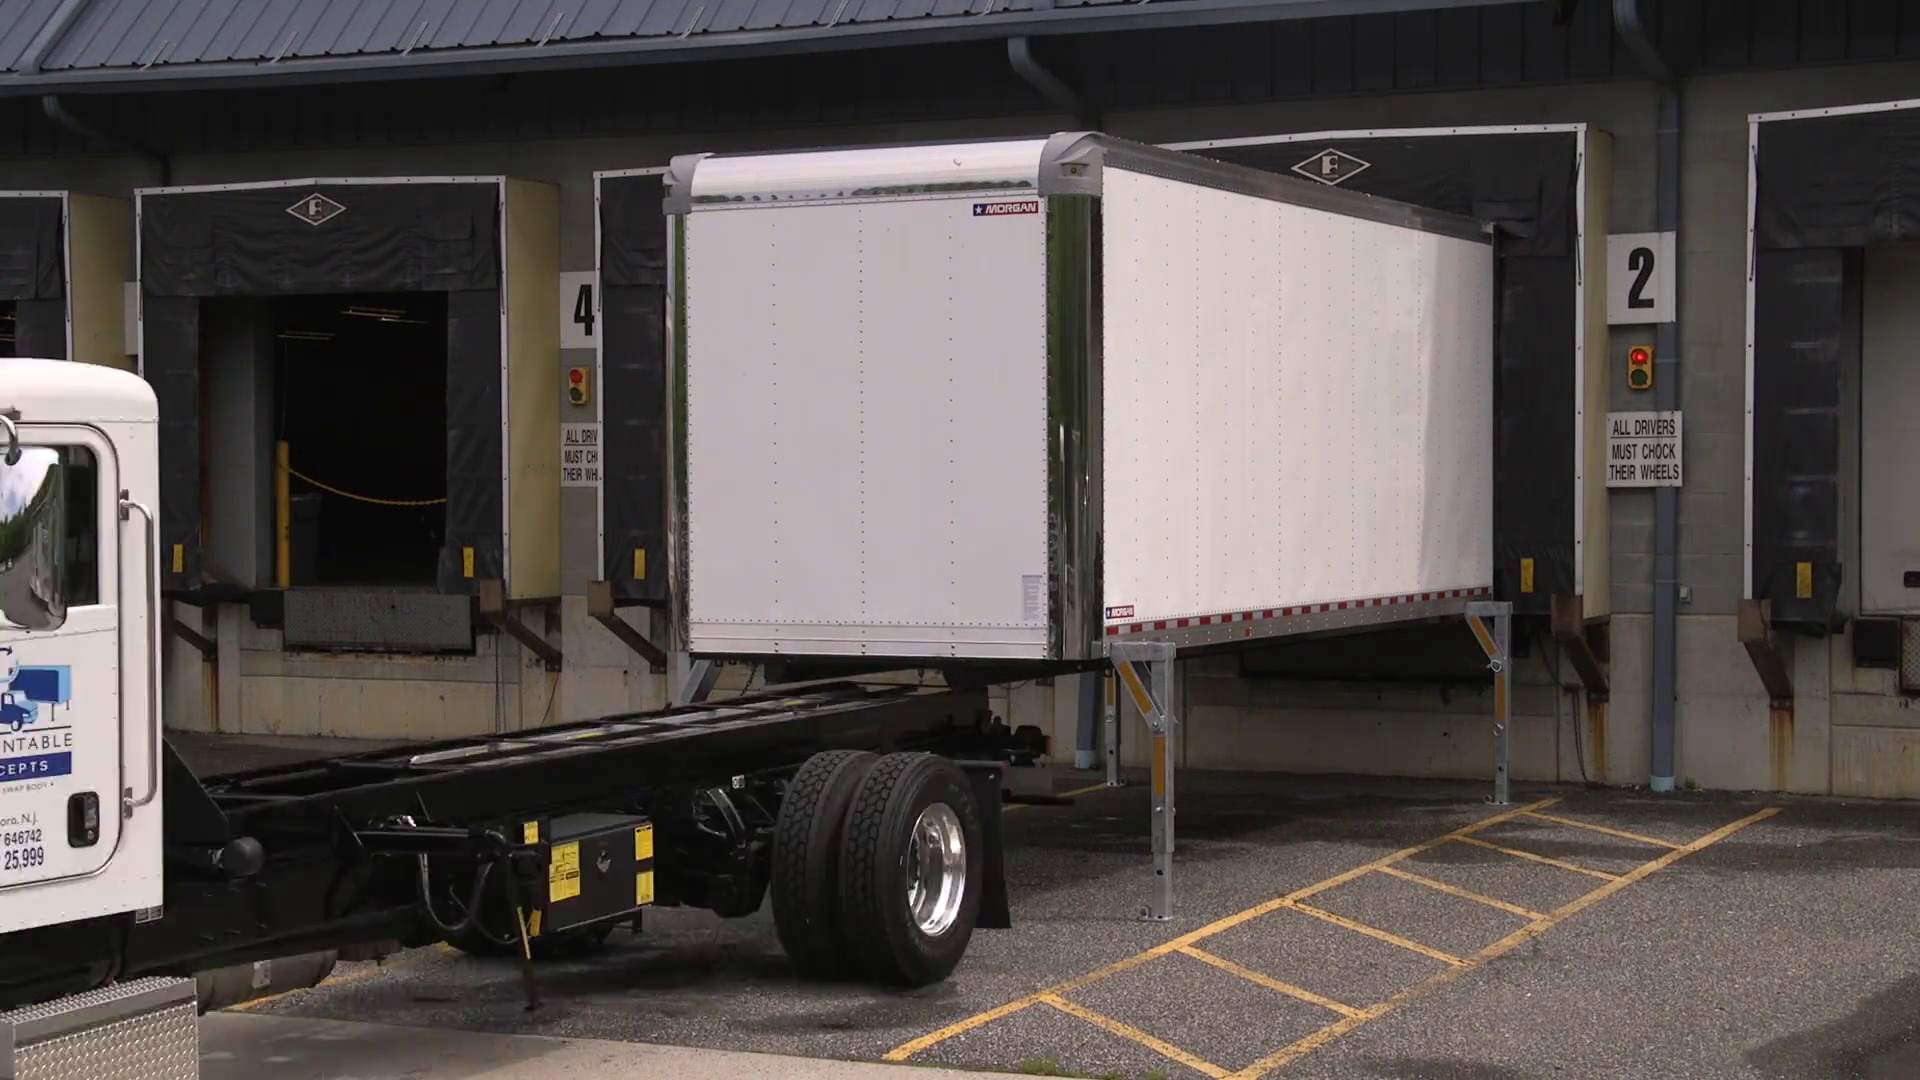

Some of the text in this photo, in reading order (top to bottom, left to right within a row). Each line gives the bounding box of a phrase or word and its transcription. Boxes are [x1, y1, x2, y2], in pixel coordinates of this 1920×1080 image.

[985, 203, 1037, 214] MORGAN
[1628, 247, 1655, 309] 2
[573, 284, 595, 336] 4
[565, 429, 579, 443] ALL
[1613, 419, 1675, 436] ALL DRIVERS
[564, 450, 598, 463] MUST CH
[1612, 443, 1676, 460] MUST CHOCK
[562, 468, 582, 481] THEIR
[1609, 463, 1680, 480] THEIR WHEELS
[4, 828, 42, 846] 646742
[4, 846, 44, 870] 25,999
